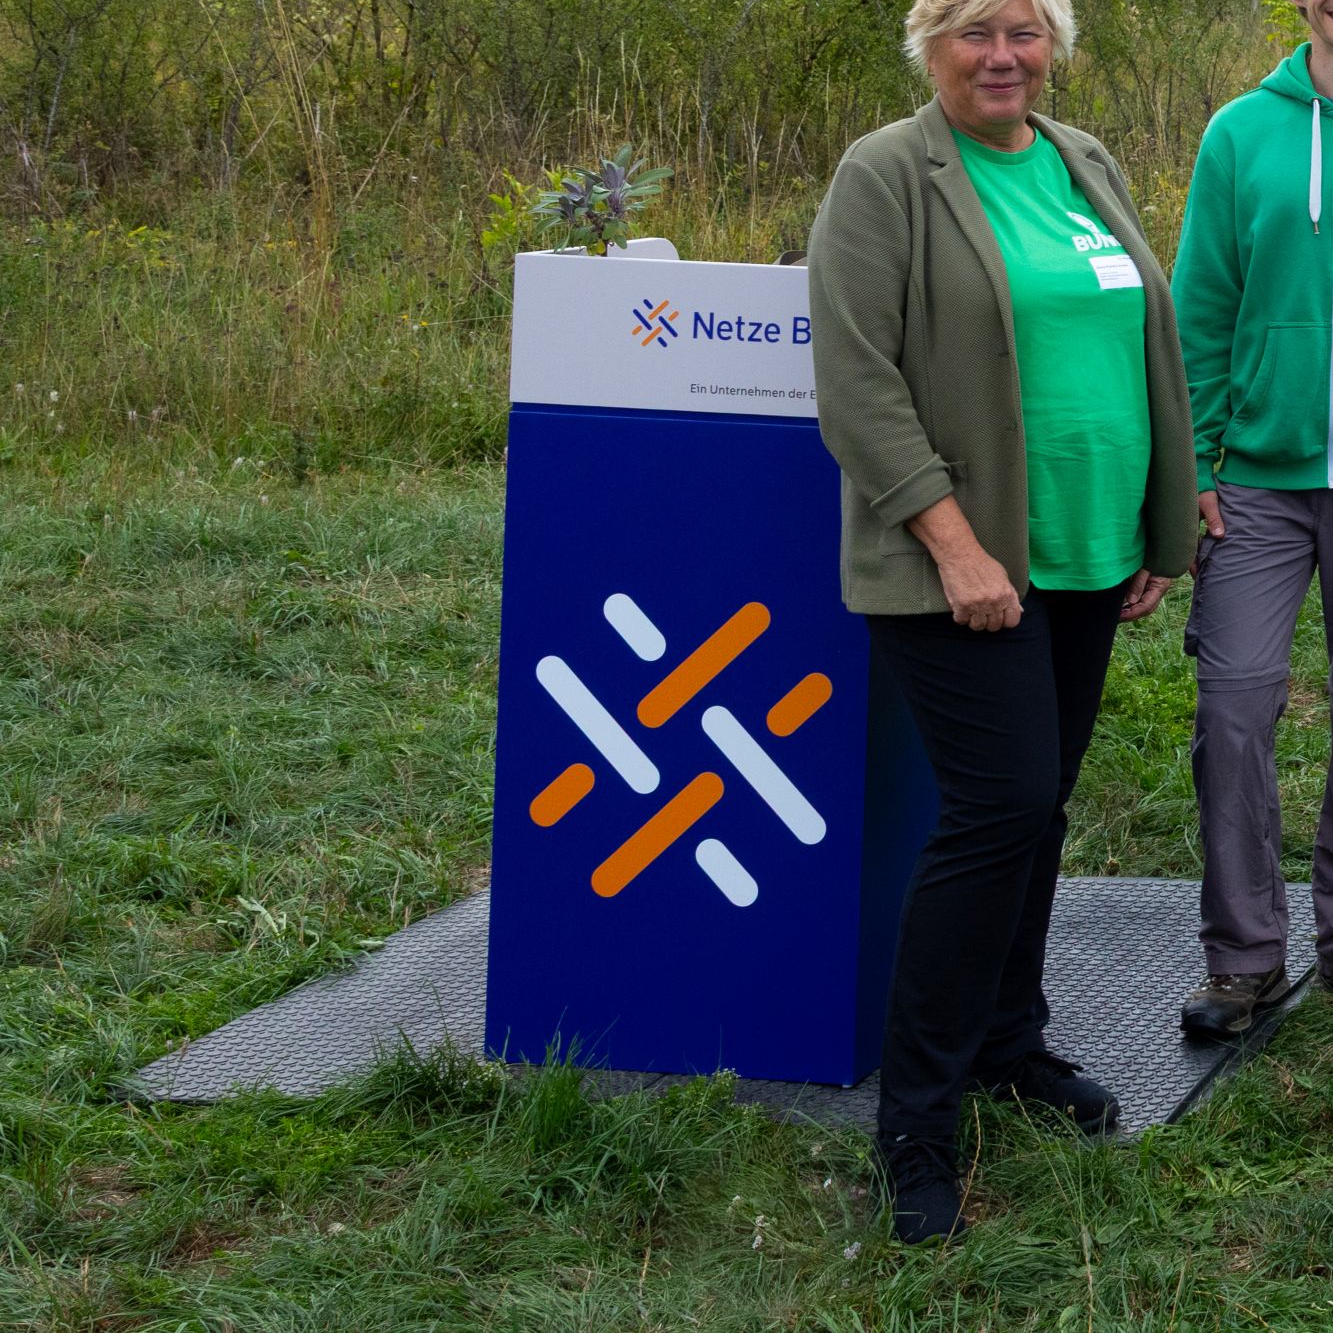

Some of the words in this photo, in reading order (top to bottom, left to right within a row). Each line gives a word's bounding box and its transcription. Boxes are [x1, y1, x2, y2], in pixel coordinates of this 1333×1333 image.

[1072, 234, 1121, 252] BUN
[693, 311, 781, 343] Netze
[792, 316, 812, 345] B
[690, 384, 707, 394] Ein
[710, 384, 785, 398] Unternehmen
[788, 389, 807, 399] der
